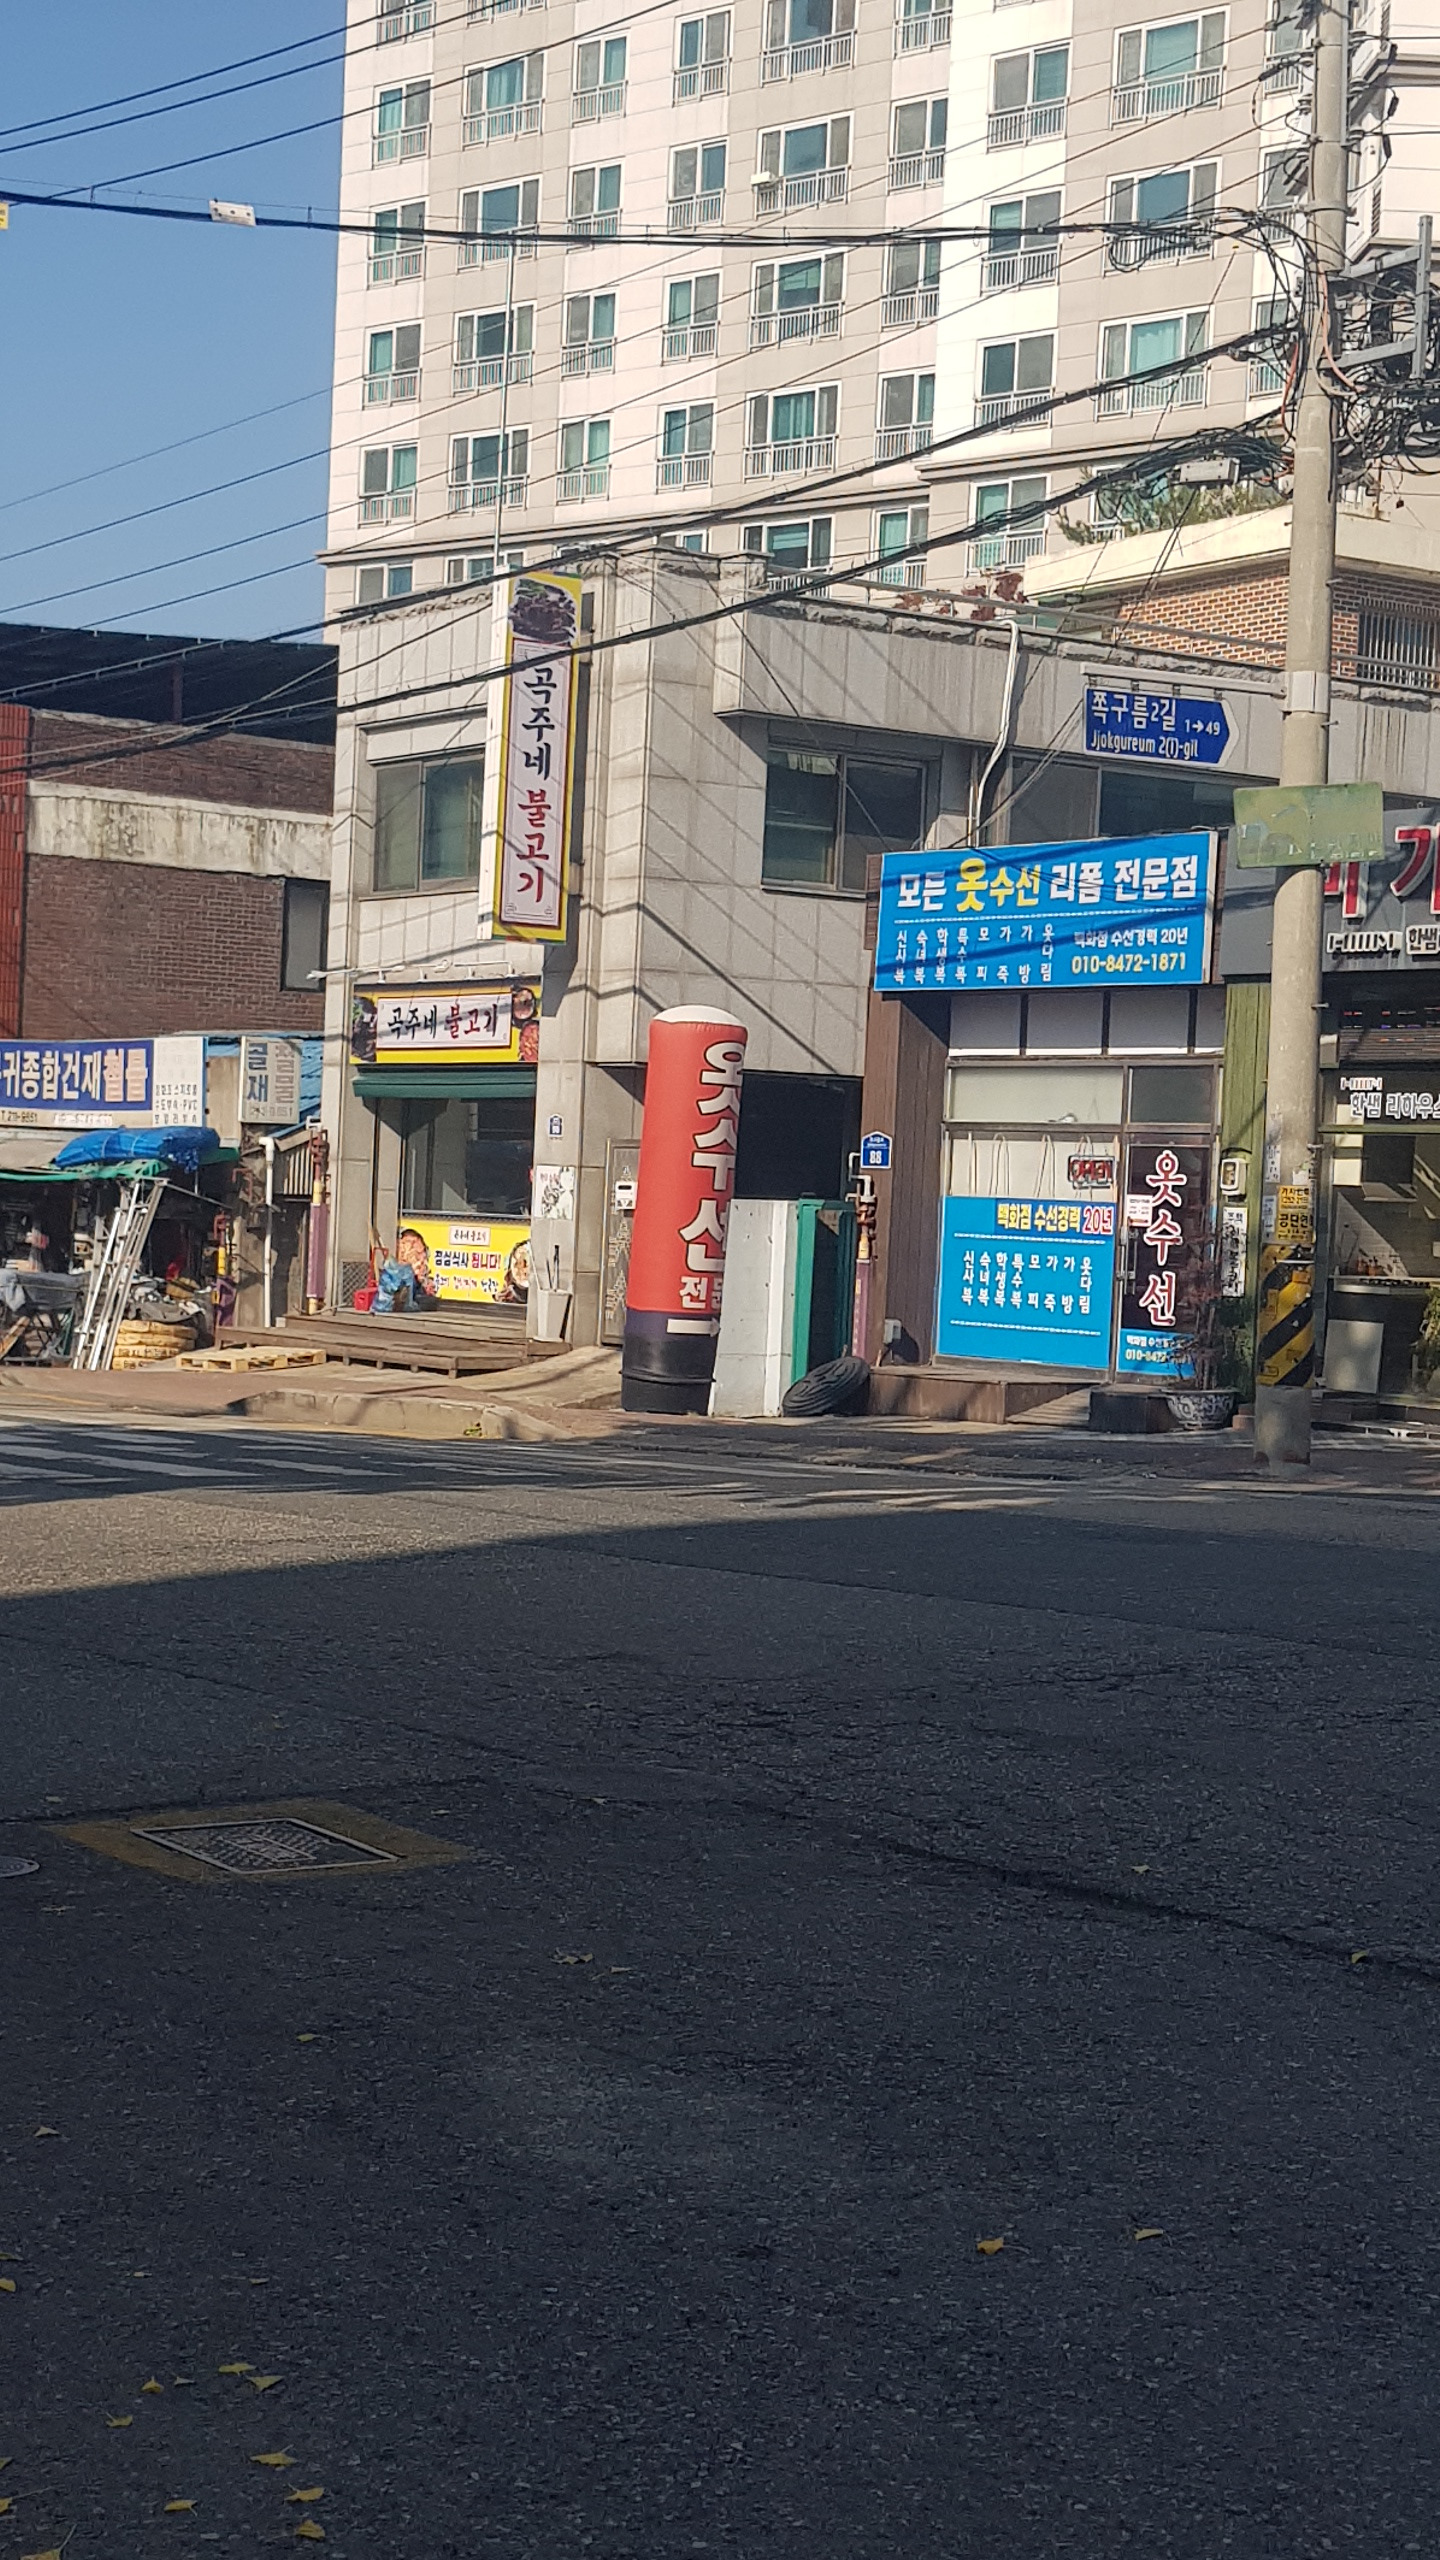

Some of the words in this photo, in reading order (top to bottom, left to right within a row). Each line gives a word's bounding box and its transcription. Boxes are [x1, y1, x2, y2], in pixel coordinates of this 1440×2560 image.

[522, 665, 557, 781] 곡주네
[1091, 691, 1176, 732] 쪽구름2길
[1205, 721, 1220, 736] 49
[1091, 729, 1156, 753] Jjokgureum
[517, 788, 551, 903] 불고기
[898, 871, 947, 911] 모든
[955, 857, 1041, 913] 옷수선
[1050, 861, 1104, 904] 리폼
[1114, 854, 1199, 902] 전문점
[1111, 928, 1157, 947] 수선경력
[1161, 927, 1188, 945] 20년
[1407, 926, 1438, 953] 한샘
[1072, 952, 1185, 974] 010-8472-1871
[387, 1004, 437, 1040] 곡주네
[445, 1003, 498, 1039] 불고기
[247, 1043, 268, 1102] 골재
[1350, 1093, 1382, 1118] 한샘
[997, 1203, 1032, 1230] 백화점
[1034, 1204, 1081, 1233] 수선경력
[1082, 1205, 1114, 1235] 20년
[1139, 1150, 1187, 1326] 옷수선
